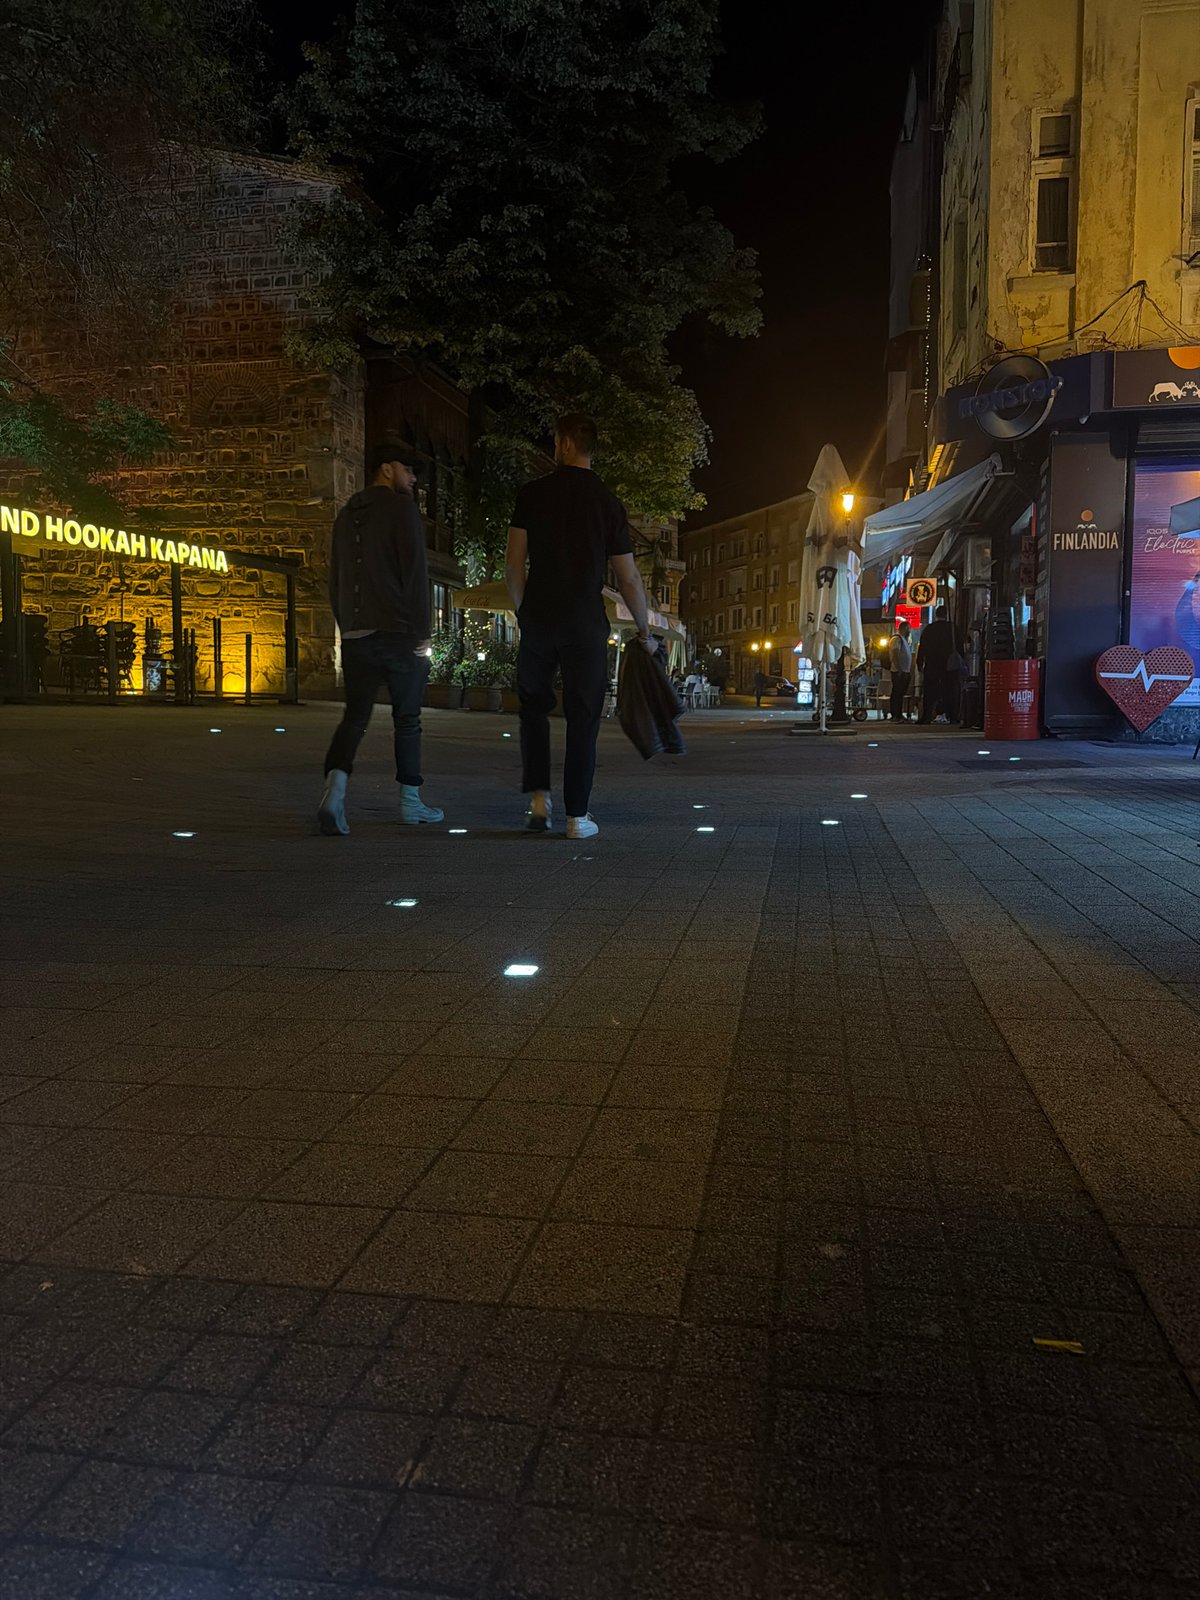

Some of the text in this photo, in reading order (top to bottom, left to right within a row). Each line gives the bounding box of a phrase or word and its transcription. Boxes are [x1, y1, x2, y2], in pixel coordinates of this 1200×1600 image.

[0, 505, 229, 572] ND HOOKAH KAPANA
[1053, 531, 1119, 551] FINLANDIA
[1144, 535, 1196, 554] Electric
